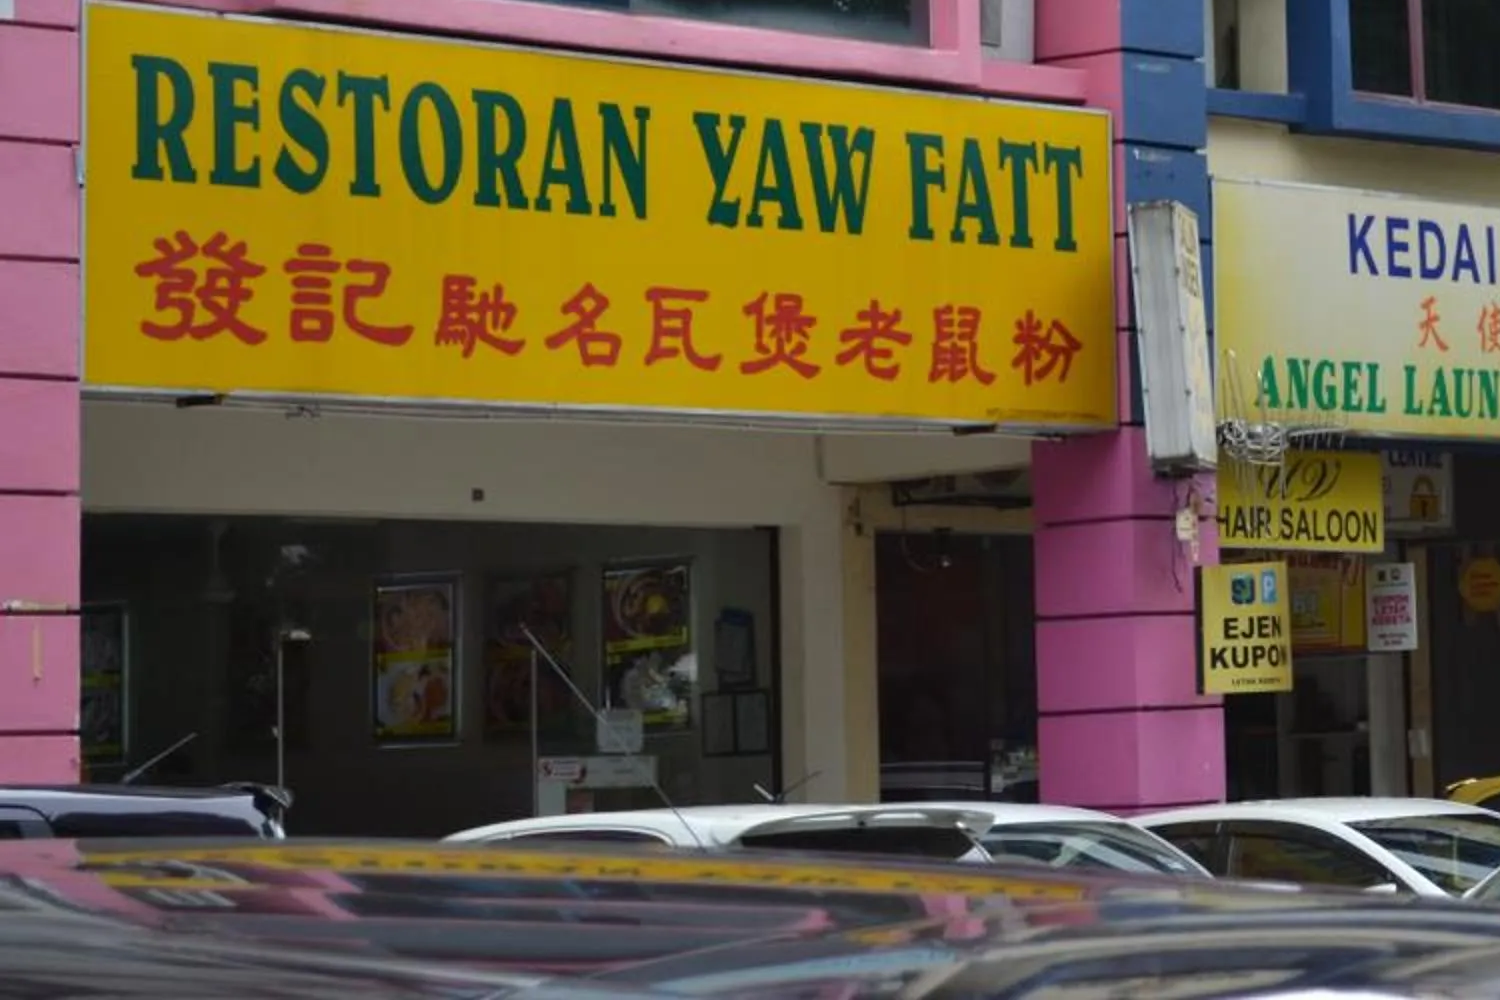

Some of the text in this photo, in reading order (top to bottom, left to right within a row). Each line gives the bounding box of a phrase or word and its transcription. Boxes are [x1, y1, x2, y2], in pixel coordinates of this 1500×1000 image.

[131, 54, 1083, 253] RESTORAN YAW FATT
[1347, 212, 1497, 285] KEDAI
[1254, 355, 1388, 414] ANGEL
[1280, 506, 1378, 544] SALOON
[1223, 615, 1282, 640] EJEN
[1210, 645, 1287, 670] KUPON
